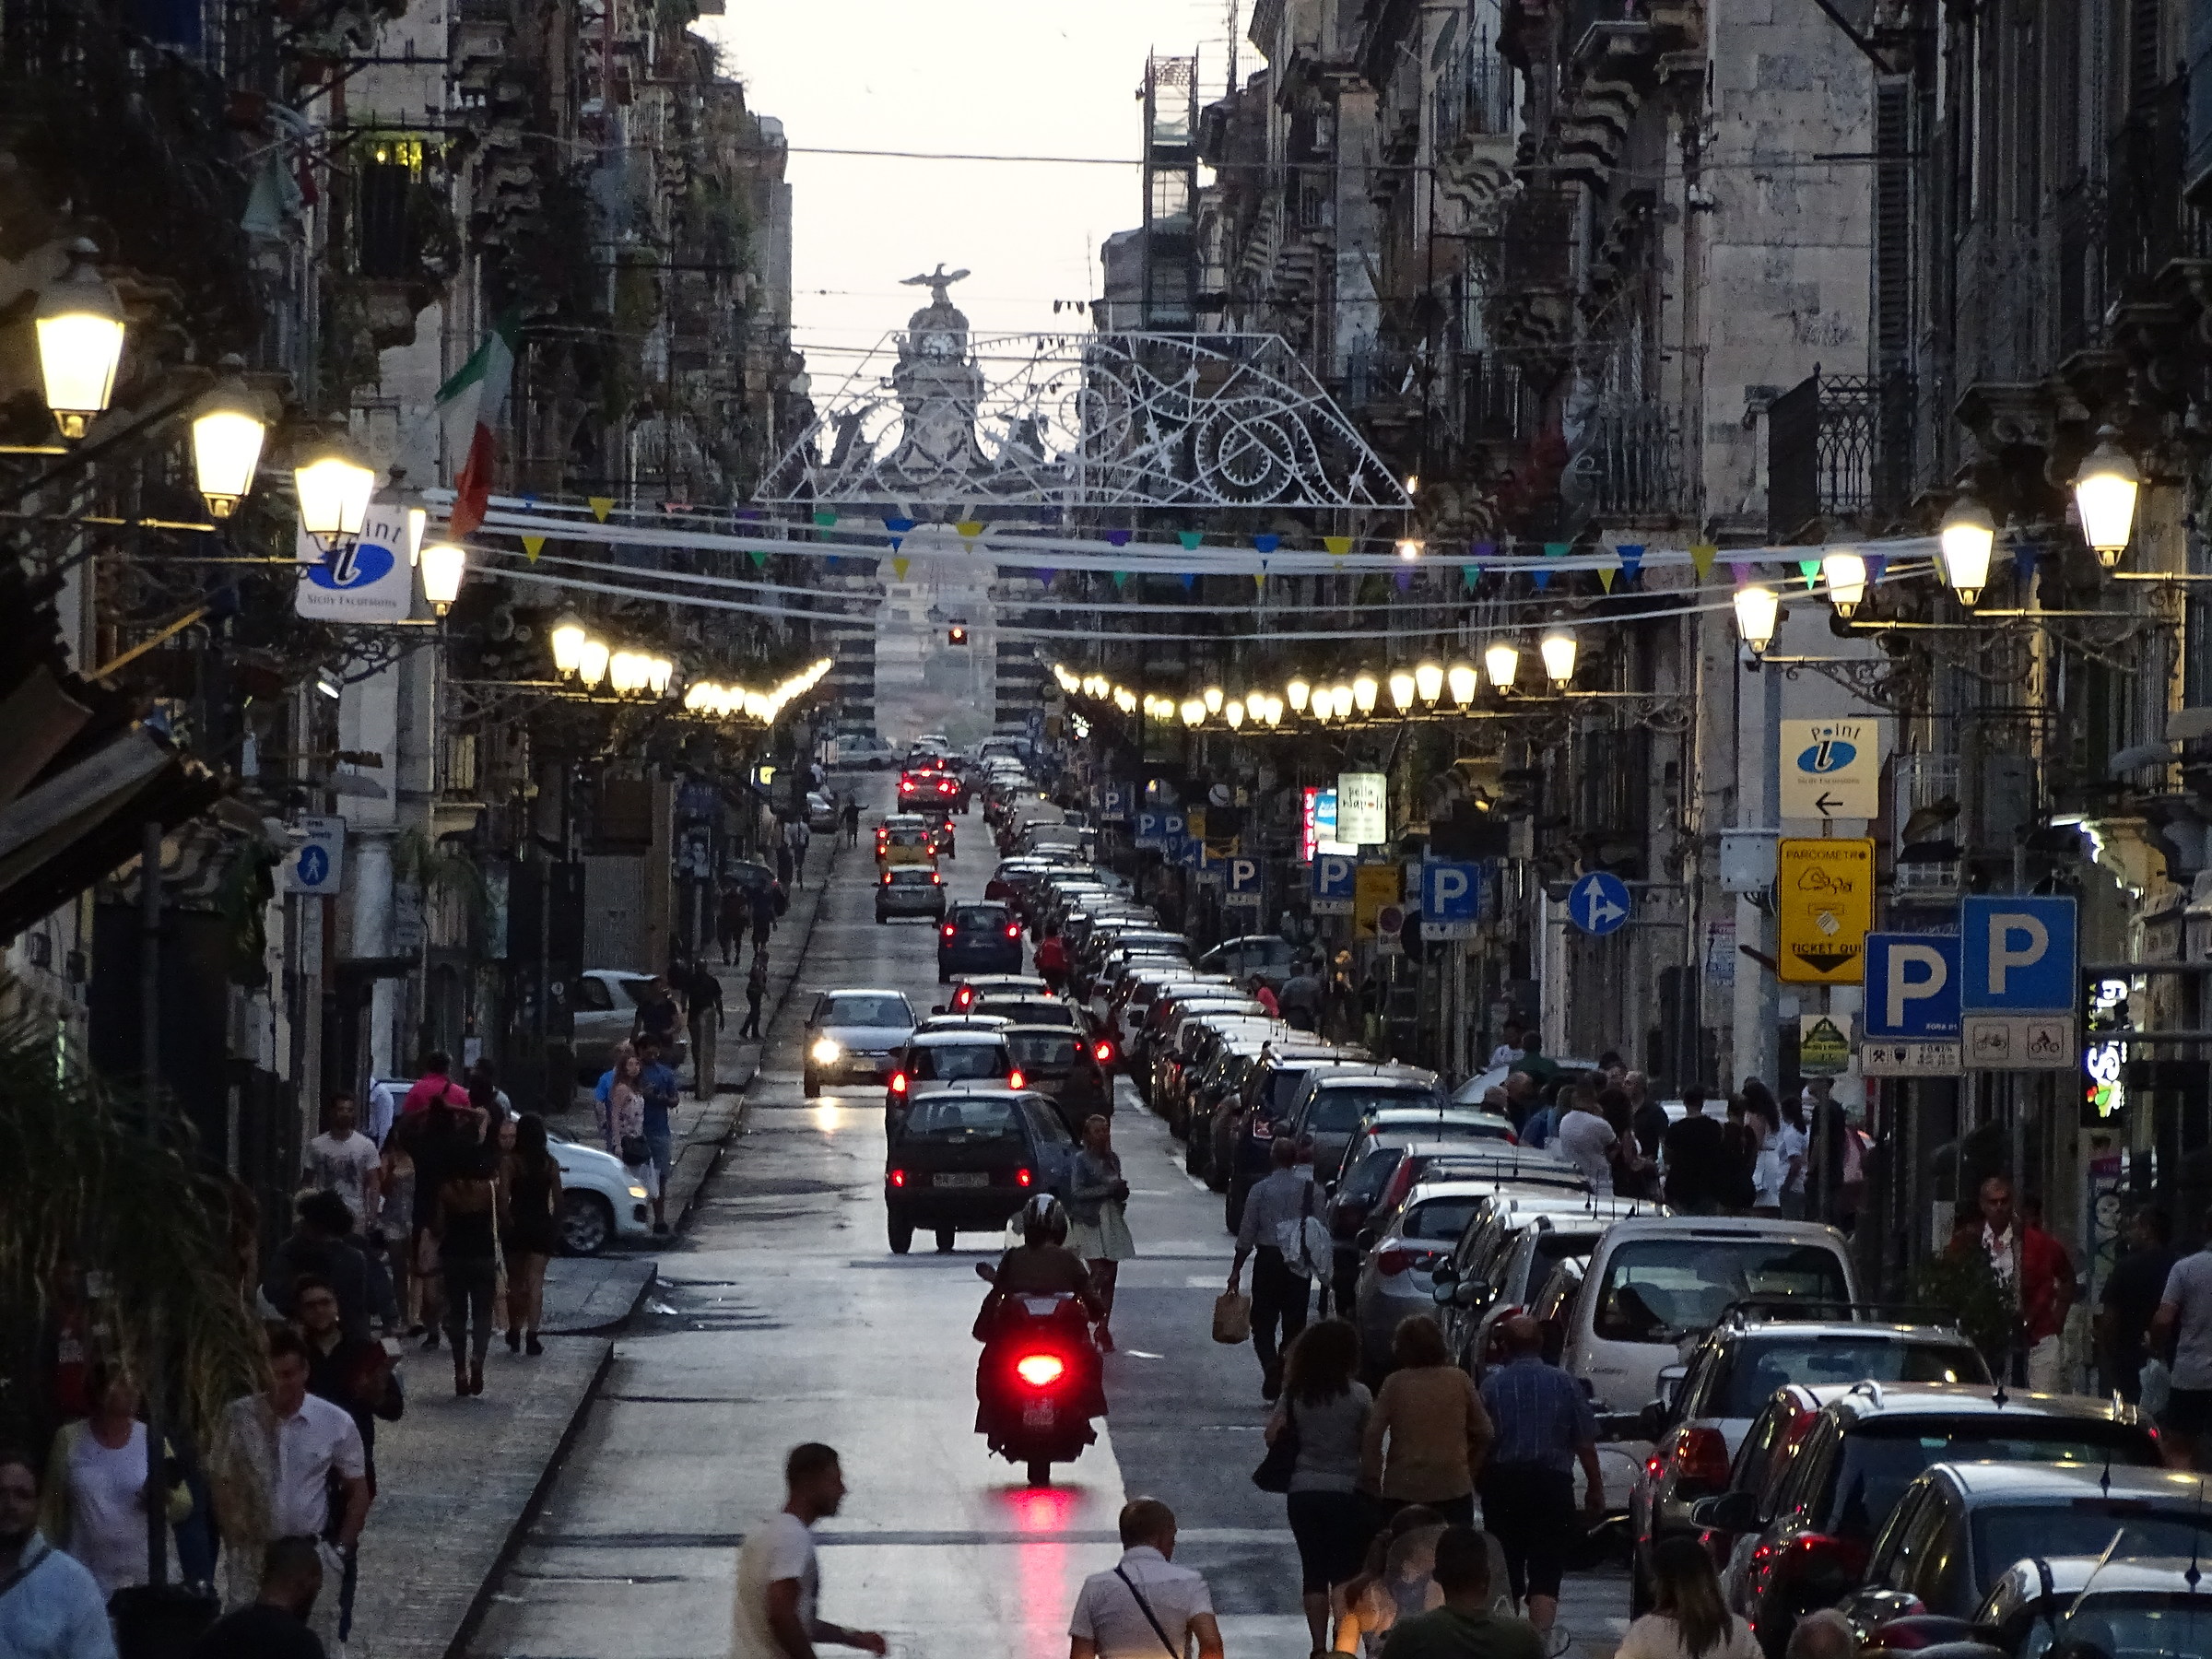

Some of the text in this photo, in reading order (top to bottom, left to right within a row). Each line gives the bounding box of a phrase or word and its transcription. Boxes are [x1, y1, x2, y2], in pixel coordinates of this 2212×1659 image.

[366, 518, 402, 544] int
[1106, 792, 1120, 812] P
[1140, 815, 1155, 835] P
[1786, 850, 1866, 860] PARCOMETRO
[1233, 860, 1255, 889] P
[1320, 857, 1348, 893] P
[1434, 868, 1468, 914] P
[1792, 943, 1862, 954] TICKET QUI
[1988, 913, 2050, 994] P
[1887, 944, 1947, 1027] P
